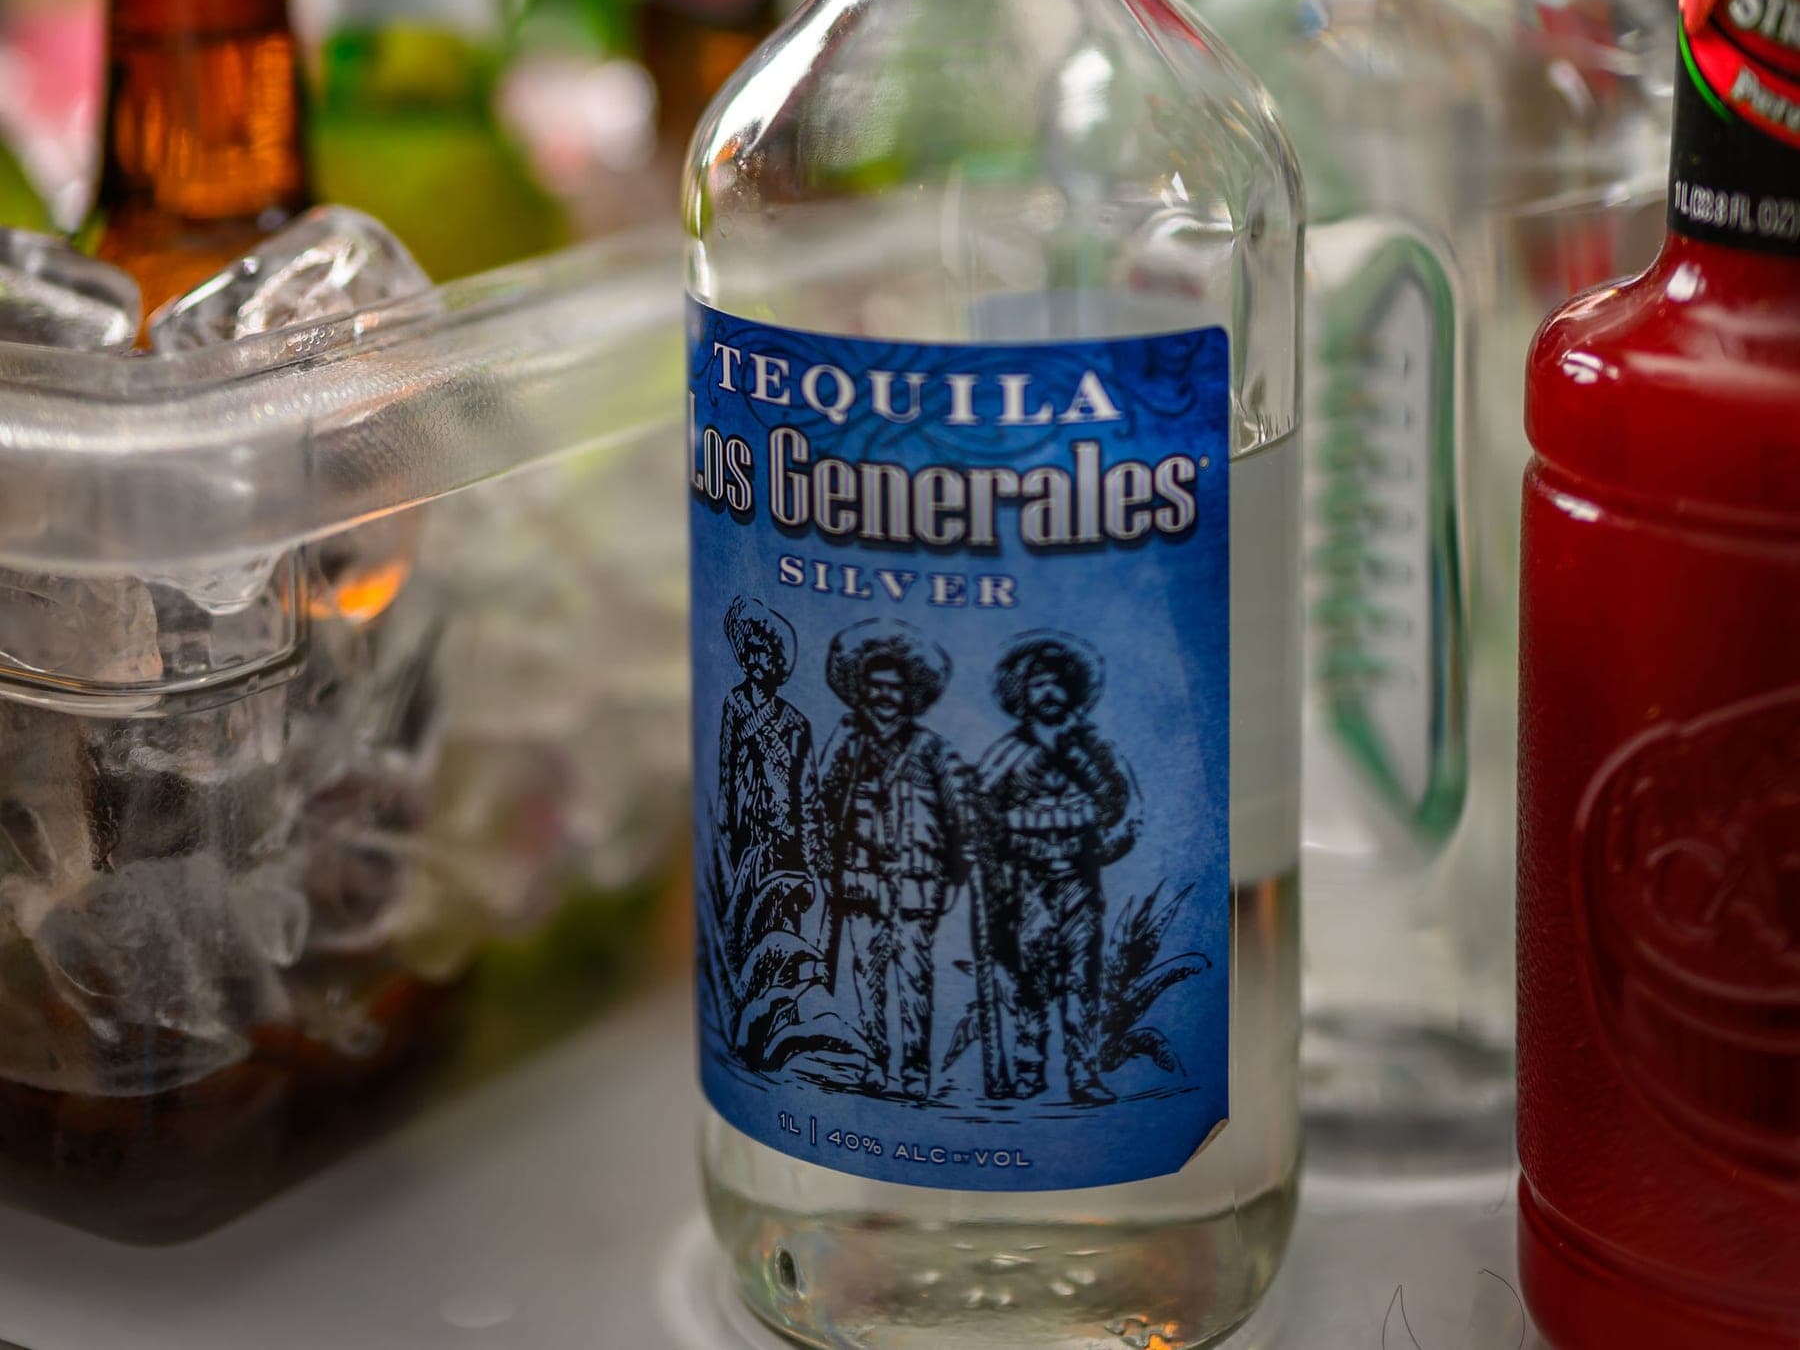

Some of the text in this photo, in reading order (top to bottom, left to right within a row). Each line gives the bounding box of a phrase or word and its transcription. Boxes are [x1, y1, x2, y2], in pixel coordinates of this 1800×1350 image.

[713, 342, 1122, 426] TEQUILA
[769, 427, 1196, 546] Generales
[780, 556, 1018, 608] SILVER
[780, 1113, 800, 1134] 1L
[828, 1131, 882, 1155] 40%
[896, 1145, 946, 1163] ALC
[975, 1151, 1030, 1167] VOL
